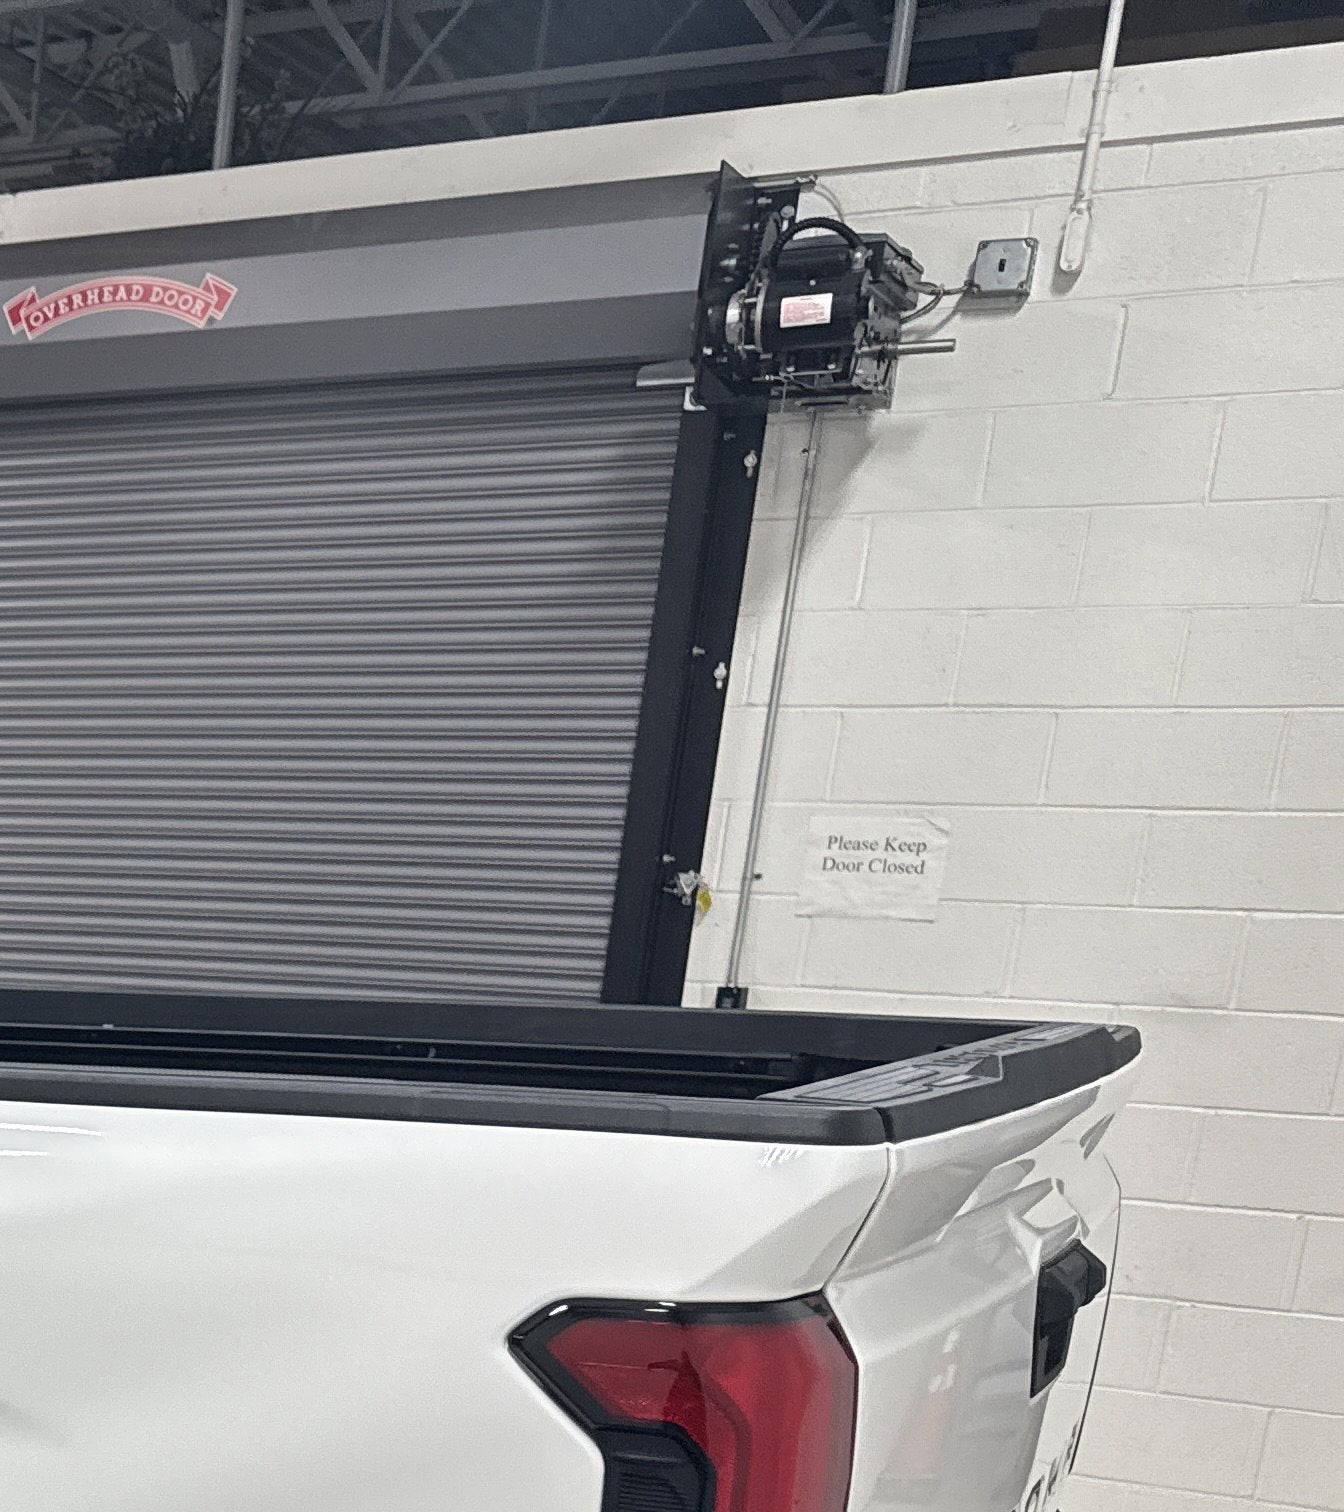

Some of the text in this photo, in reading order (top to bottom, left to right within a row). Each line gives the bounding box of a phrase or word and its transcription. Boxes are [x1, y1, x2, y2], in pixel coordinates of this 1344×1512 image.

[29, 284, 206, 328] OVERHEAD DOOR
[827, 834, 927, 857] Please Keep
[822, 855, 925, 875] Door Closed
